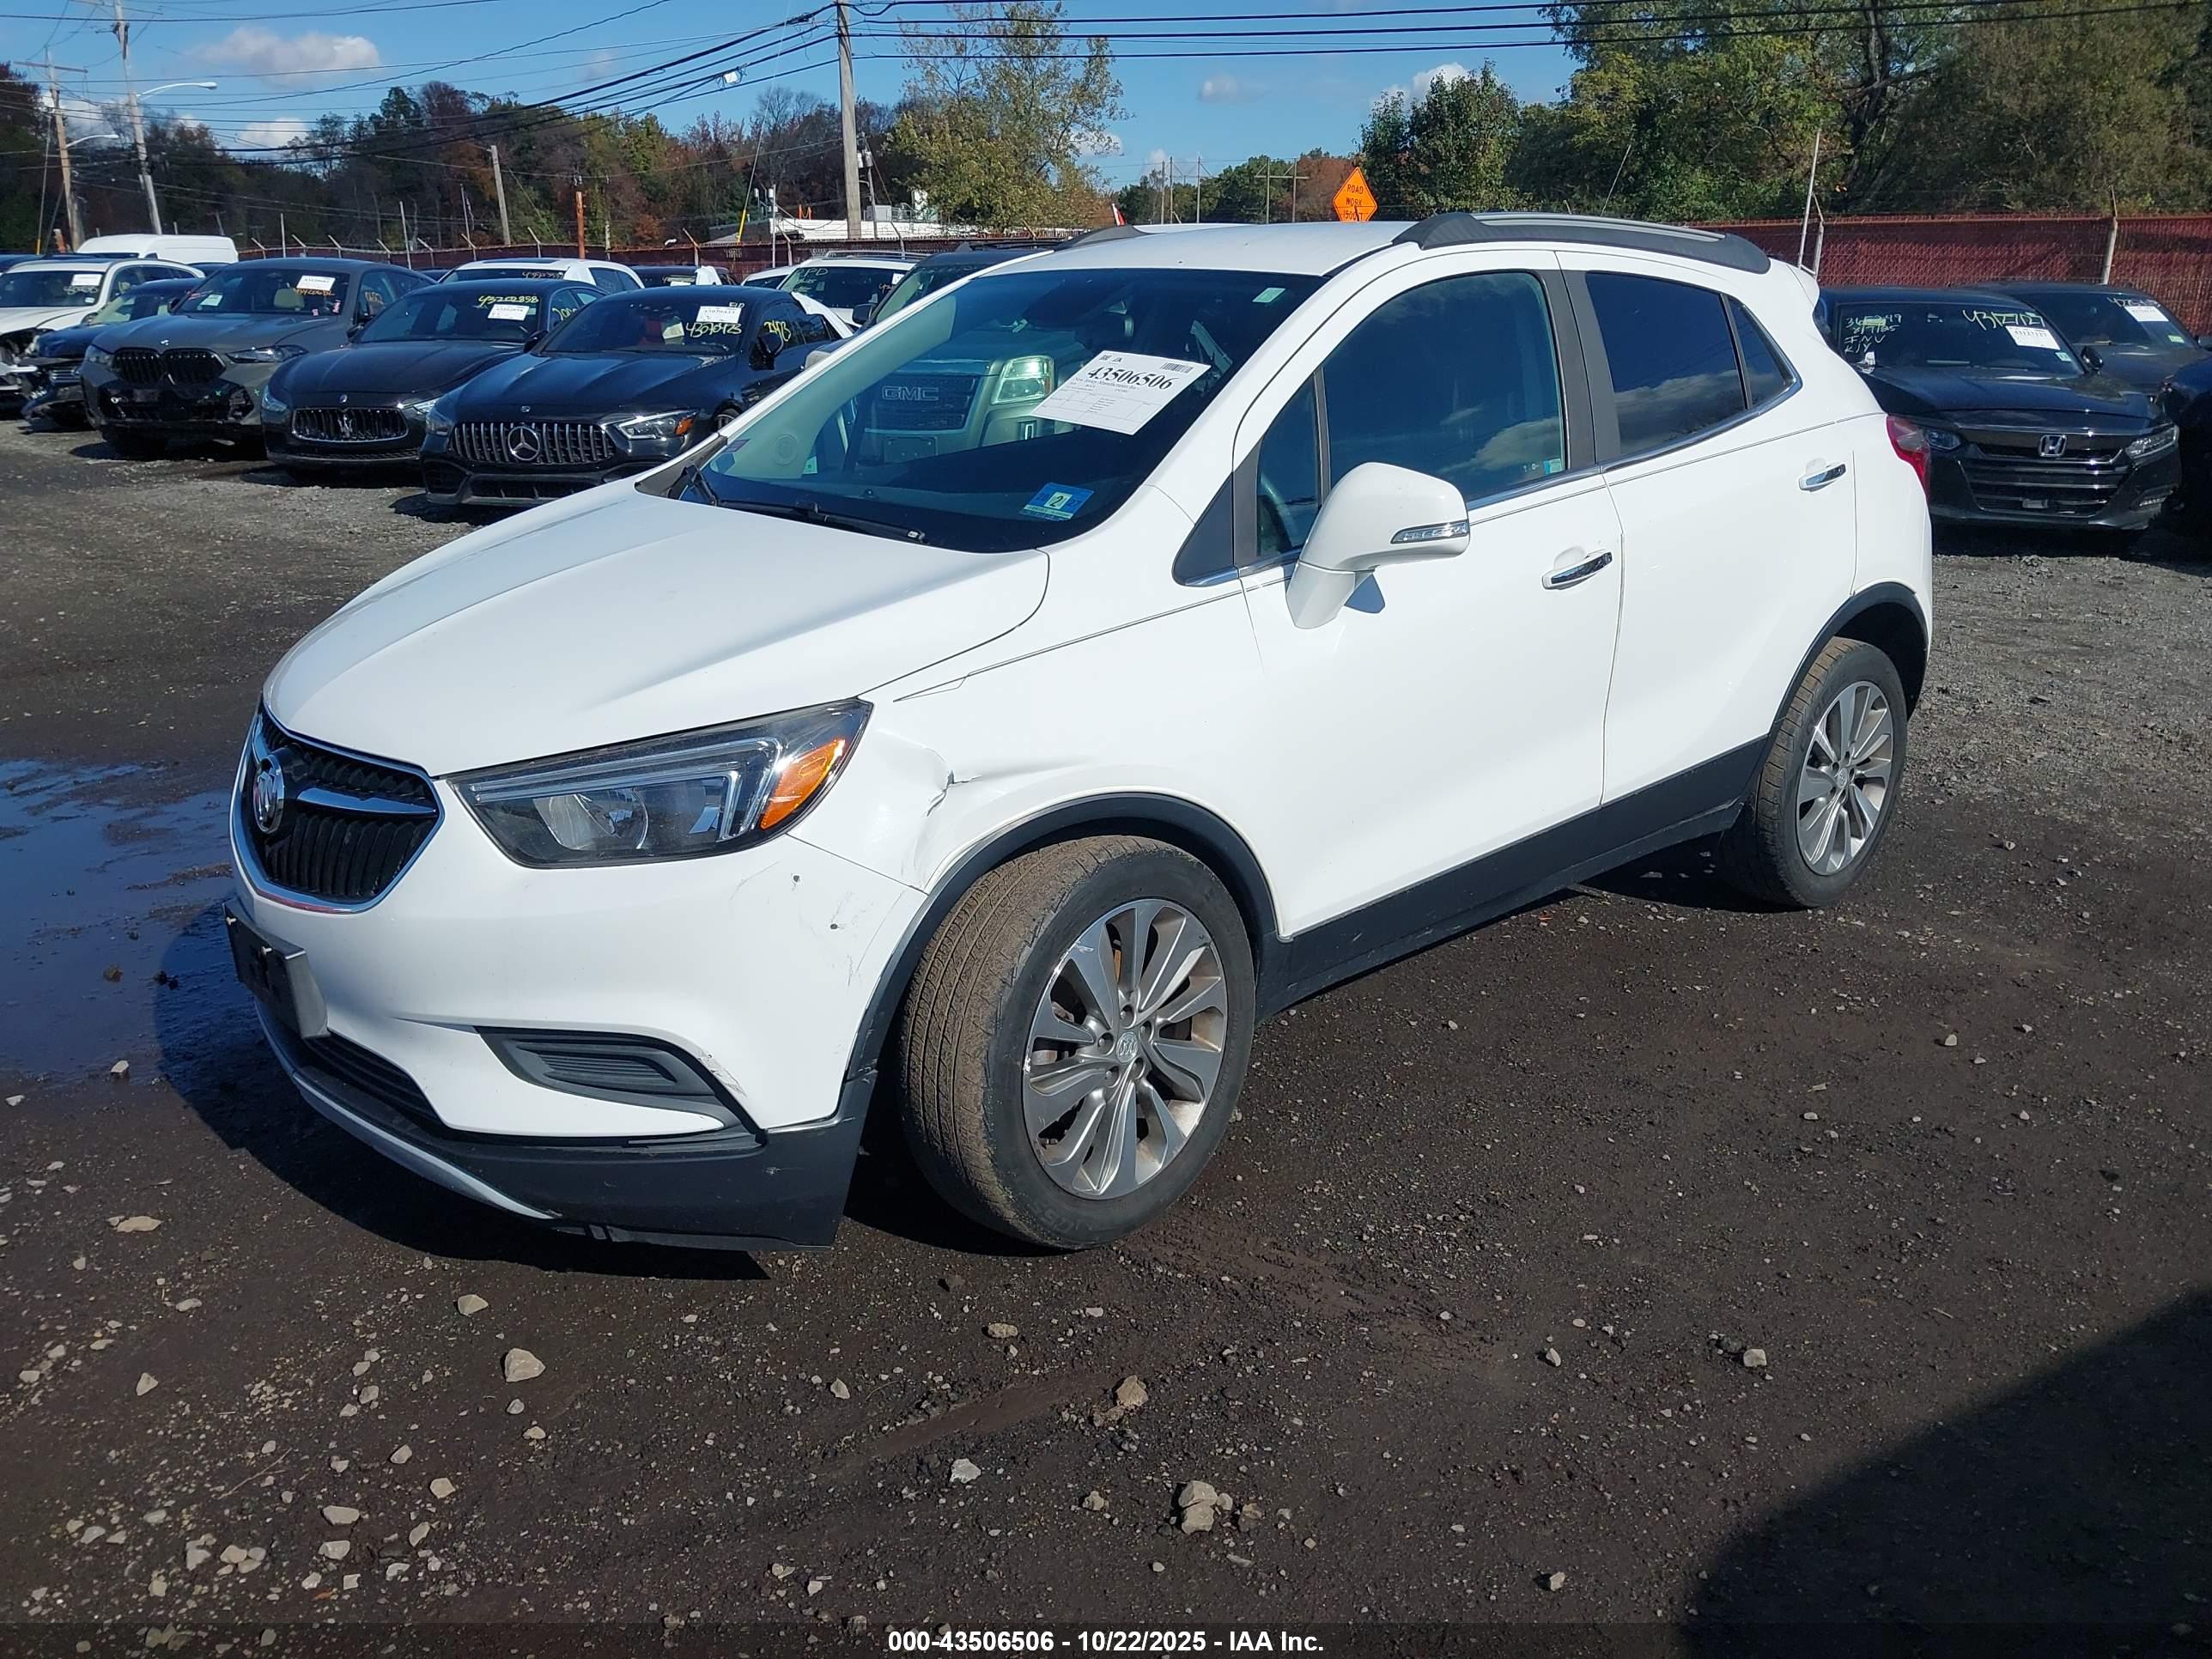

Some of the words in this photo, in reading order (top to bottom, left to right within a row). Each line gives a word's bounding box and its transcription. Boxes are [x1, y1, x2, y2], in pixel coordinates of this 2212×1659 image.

[1346, 184, 1364, 195] ROAD
[1346, 197, 1363, 207] WORK
[1088, 368, 1180, 390] 43506506
[882, 386, 939, 401] GMC
[1049, 495, 1064, 507] 2
